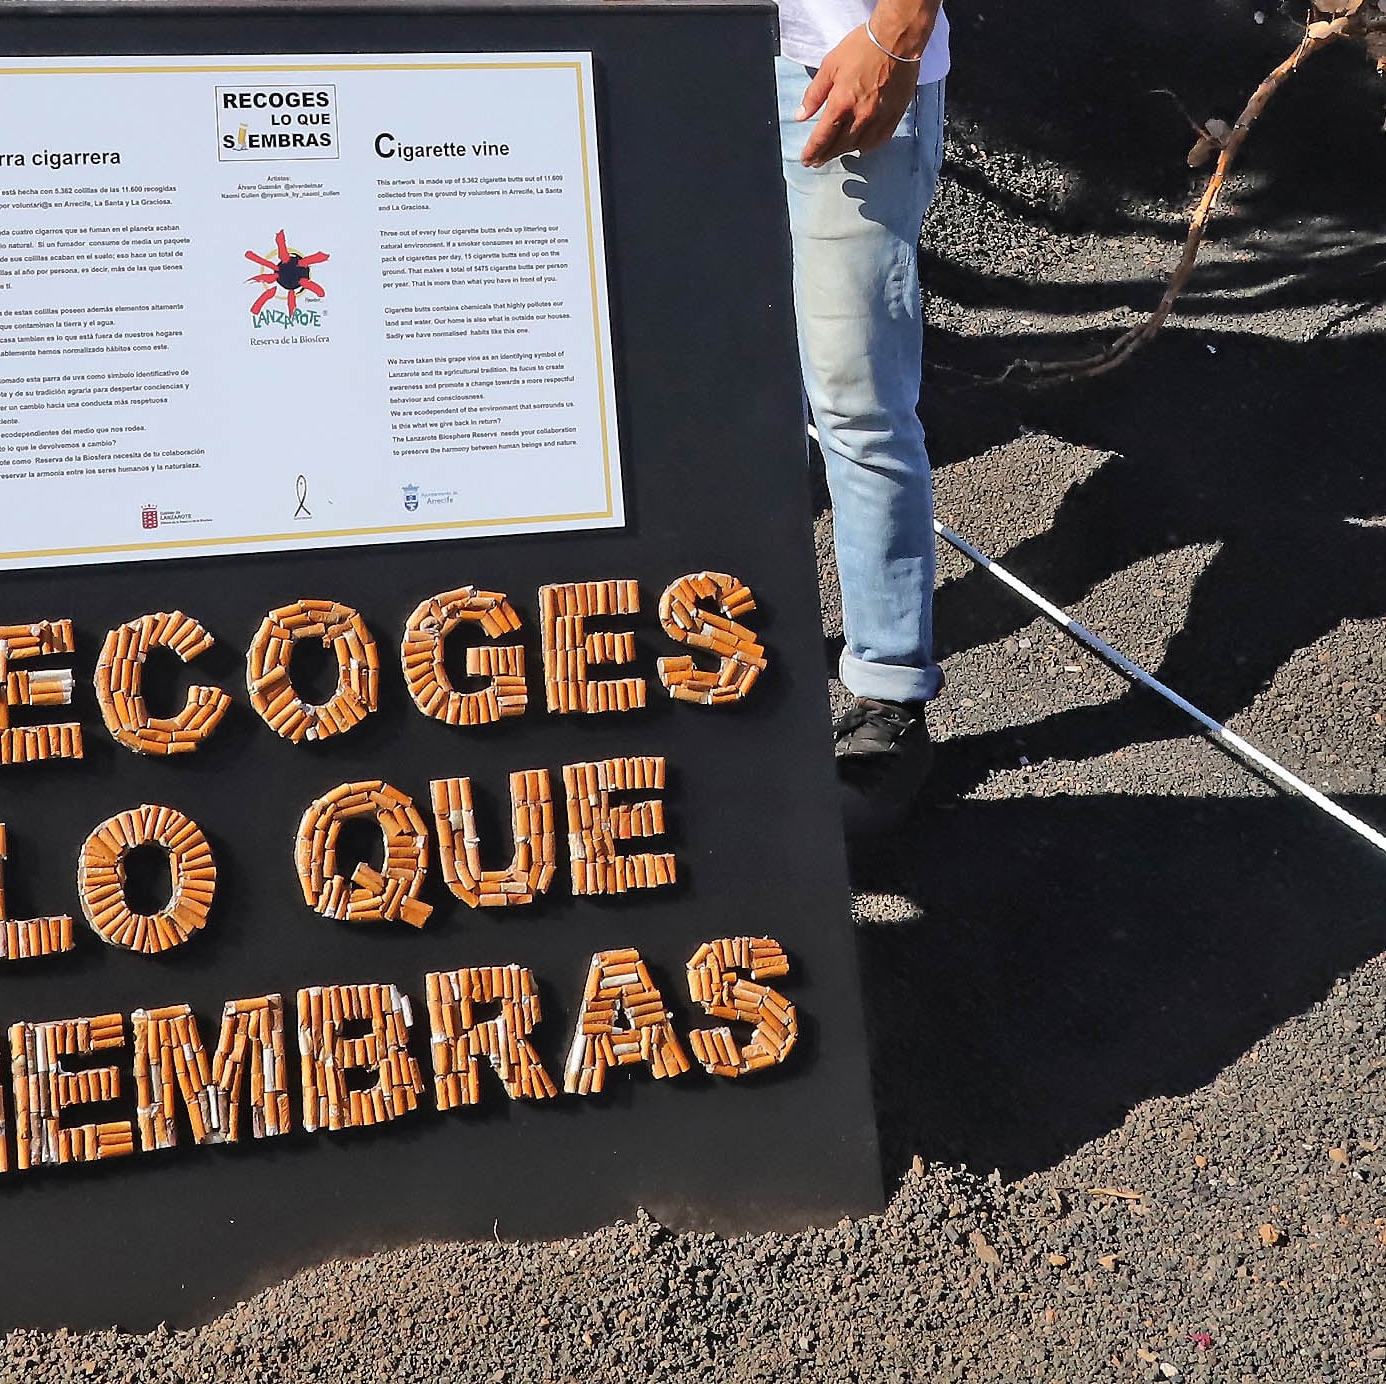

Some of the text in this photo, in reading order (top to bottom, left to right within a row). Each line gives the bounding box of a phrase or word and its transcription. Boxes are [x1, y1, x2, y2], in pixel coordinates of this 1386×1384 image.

[223, 92, 329, 108] RECOGES
[271, 114, 330, 126] LO QUE
[374, 132, 510, 162] Cigarette vine
[32, 150, 121, 170] cigarrera
[391, 177, 415, 185] artwork
[425, 176, 443, 184] made
[479, 175, 506, 184] cigarette
[17, 188, 38, 196] hecha
[73, 186, 98, 194] colillas
[143, 185, 176, 194] recogidas
[378, 190, 406, 198] collected
[407, 190, 422, 198] from
[434, 189, 457, 198] ground
[458, 189, 466, 198] by
[467, 188, 500, 196] volunteers
[544, 186, 562, 194] Santa
[104, 199, 123, 207] Santa
[11, 227, 33, 236] cuatro
[34, 227, 63, 236] cigarros
[88, 225, 110, 234] fuman
[129, 224, 154, 234] planeta
[155, 223, 180, 232] acaban
[380, 229, 398, 237] Three
[437, 227, 450, 235] four
[451, 226, 478, 236] cigarette
[480, 226, 496, 234] butts
[497, 225, 512, 233] ends
[523, 224, 546, 234] littering
[56, 240, 85, 248] fumador
[131, 238, 151, 246] media
[163, 237, 190, 246] paquete
[252, 308, 322, 329] LANZAROTE
[13, 321, 54, 330] contaminan
[63, 320, 81, 328] tierra
[386, 331, 403, 340] Sadly
[415, 330, 431, 338] have
[432, 328, 467, 337] normalised
[470, 328, 489, 336] habits
[490, 327, 502, 335] like
[503, 327, 514, 335] this
[250, 334, 330, 346] Reserva de la Biosfera
[0, 428, 59, 440] ecodependientes
[60, 428, 71, 436] del
[72, 427, 94, 435] medio
[426, 496, 454, 504] Arrecife
[293, 755, 679, 930] QUE
